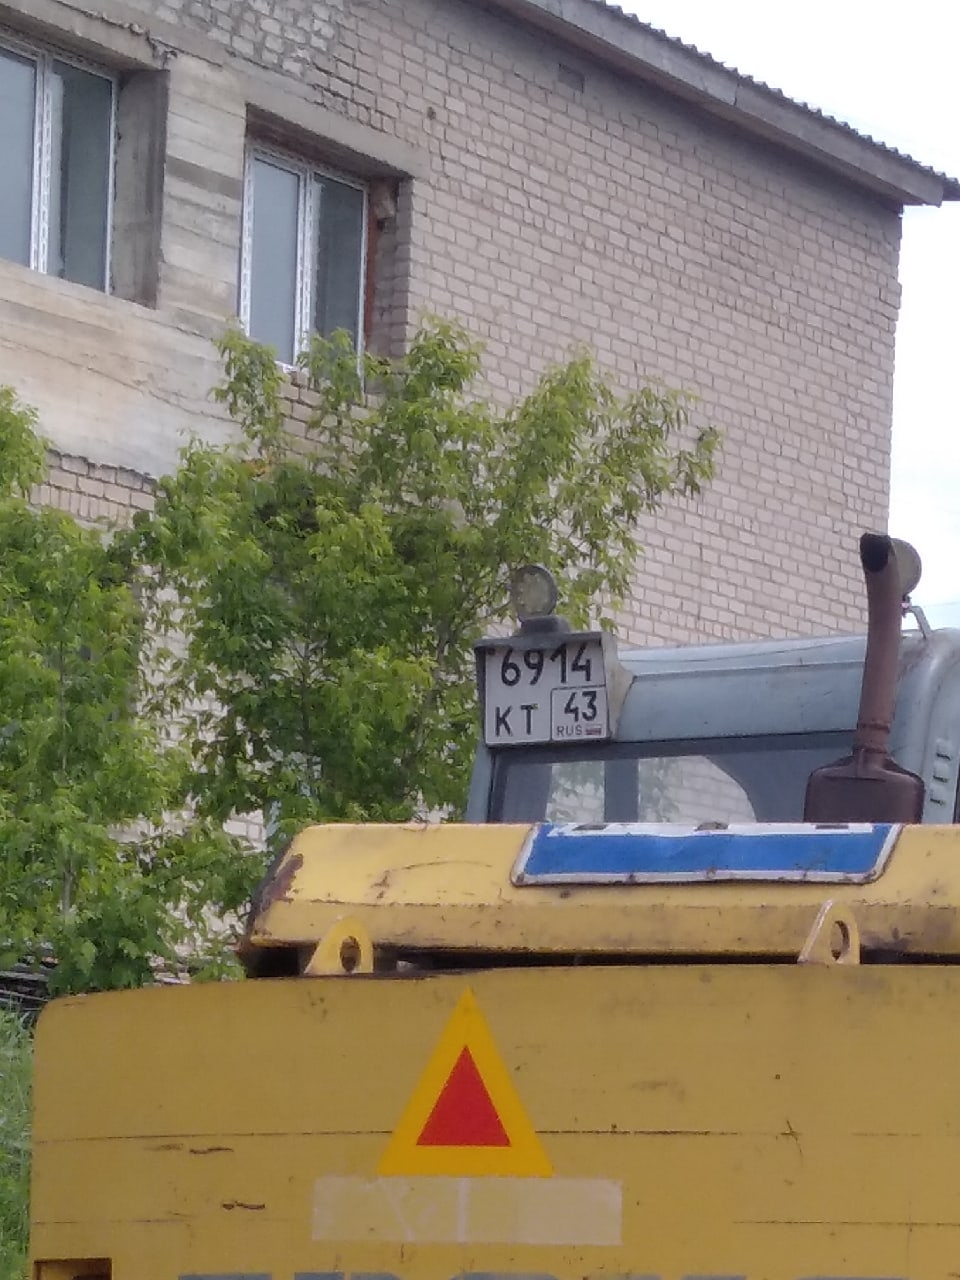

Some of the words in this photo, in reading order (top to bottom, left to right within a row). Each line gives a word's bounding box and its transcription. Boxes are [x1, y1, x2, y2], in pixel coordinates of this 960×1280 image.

[501, 643, 591, 686] 6914
[564, 690, 598, 722] 43
[556, 726, 582, 736] RUS
